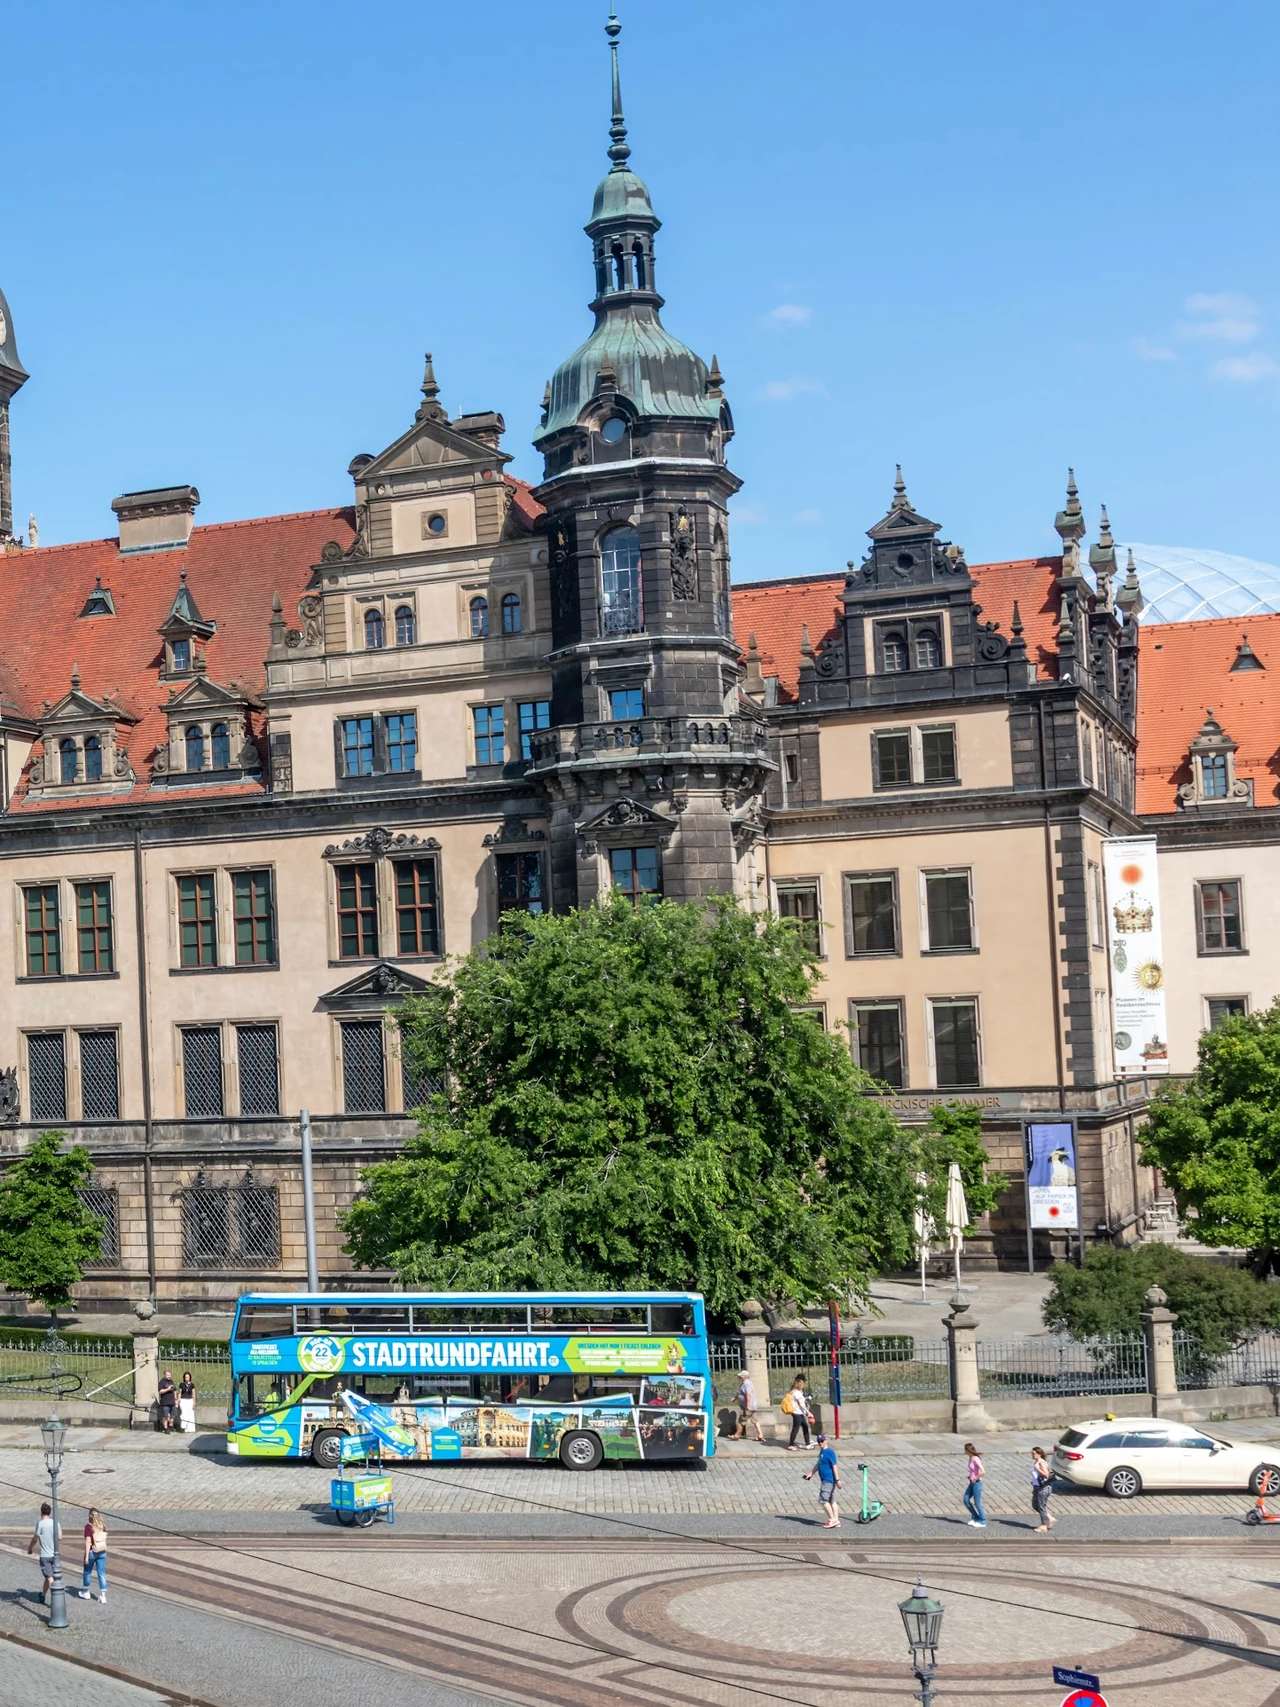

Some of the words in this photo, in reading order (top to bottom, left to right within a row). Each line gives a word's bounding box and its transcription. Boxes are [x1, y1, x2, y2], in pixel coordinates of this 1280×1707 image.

[315, 1347, 328, 1357] 22
[352, 1341, 550, 1367] STADTRUNDFAHRT
[1057, 1671, 1094, 1688] Sophienstr.
